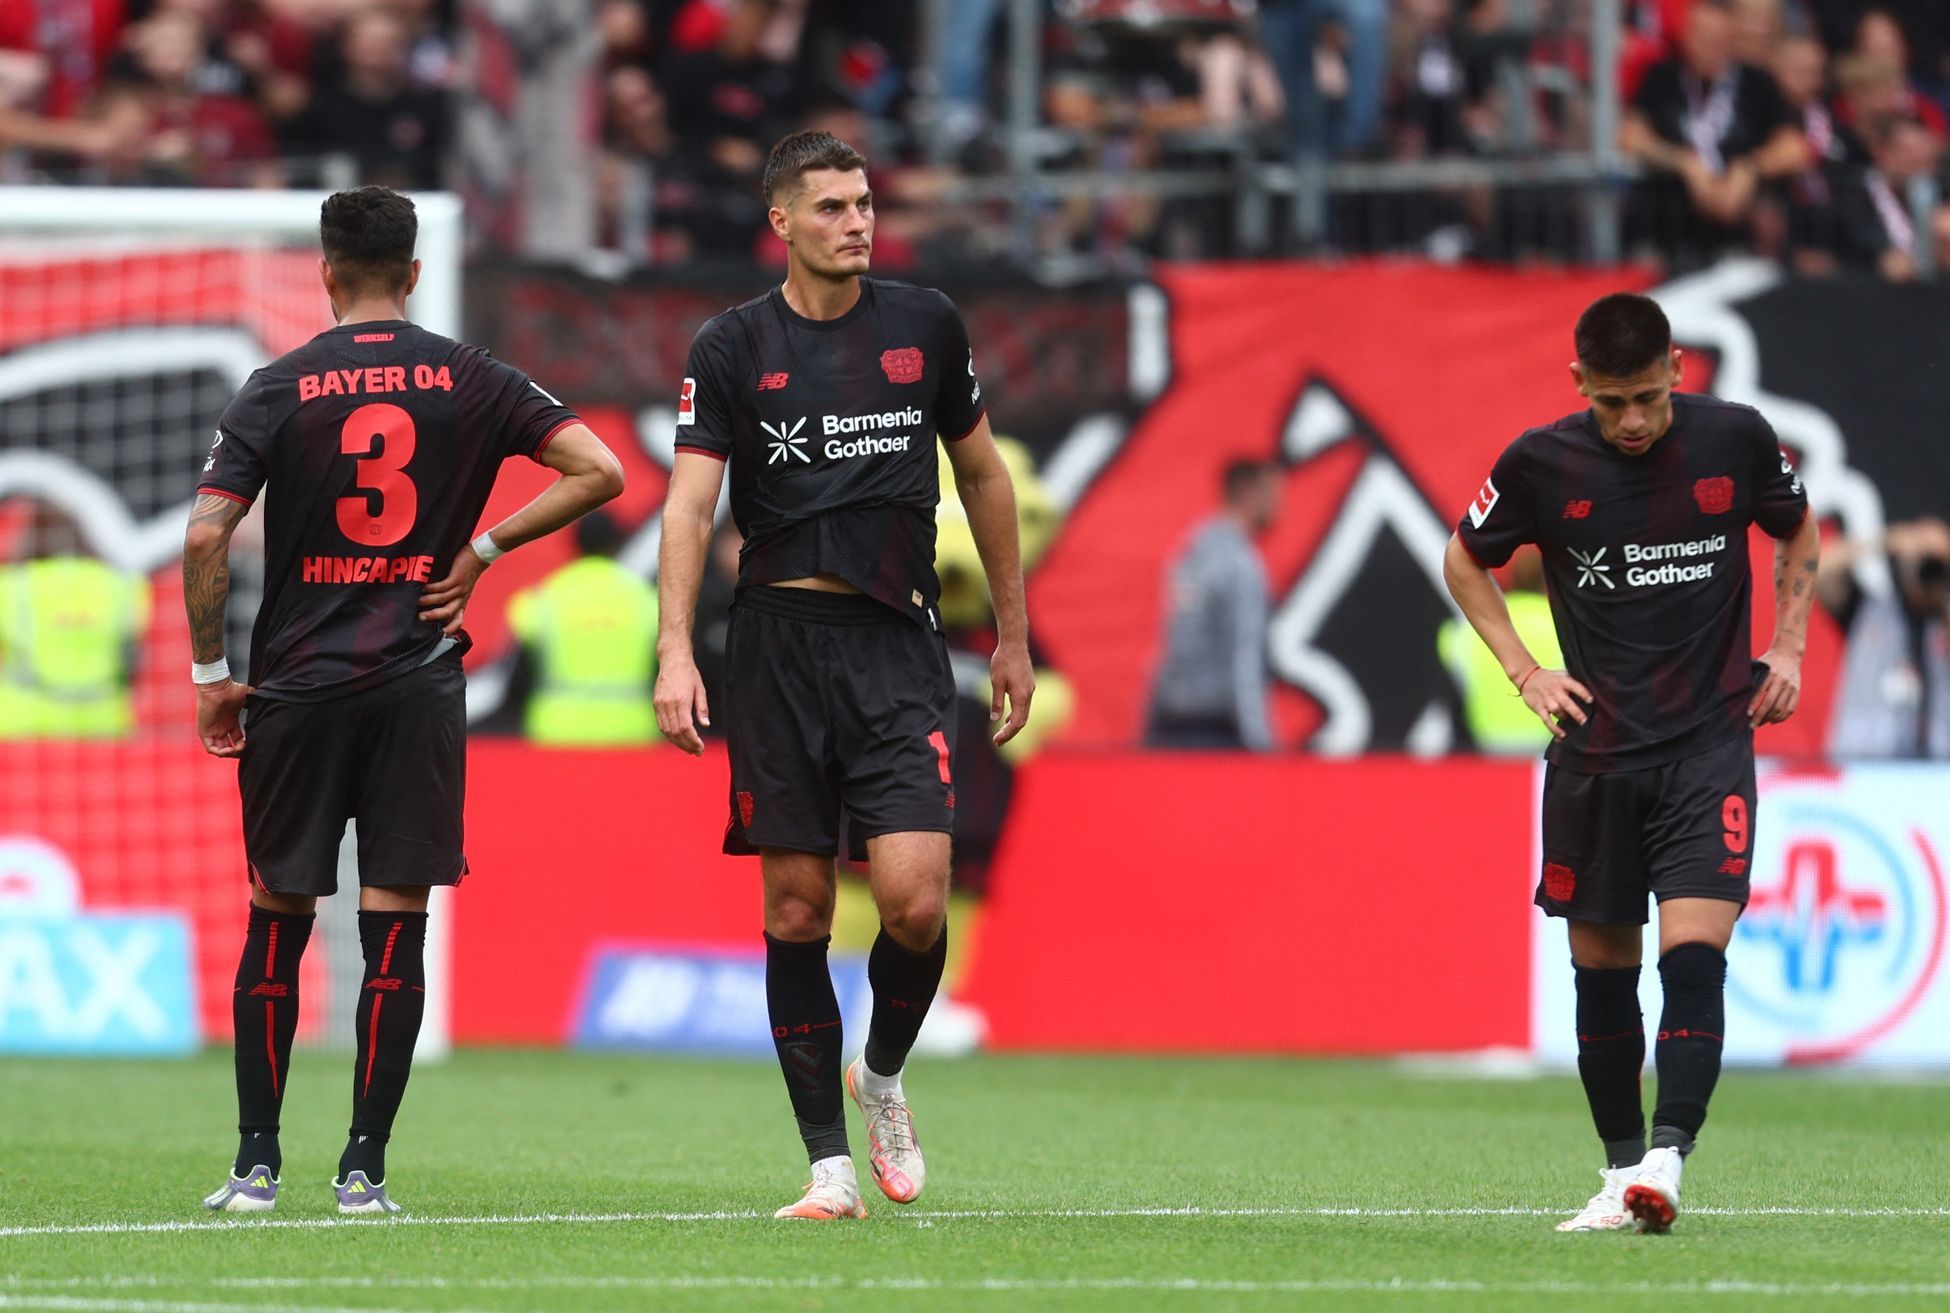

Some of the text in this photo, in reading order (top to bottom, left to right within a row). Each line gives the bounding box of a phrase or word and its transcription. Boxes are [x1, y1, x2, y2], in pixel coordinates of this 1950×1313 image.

[354, 333, 396, 343] WERKSELF
[299, 364, 453, 401] BAYER 04
[822, 405, 922, 435] Barmenia
[824, 435, 910, 459] Gothaer
[336, 403, 417, 547] 3
[1623, 534, 1726, 562] Barmenia
[303, 555, 434, 583] HINCAPIE
[1626, 562, 1714, 586] Gothaer
[1722, 795, 1748, 853] 9
